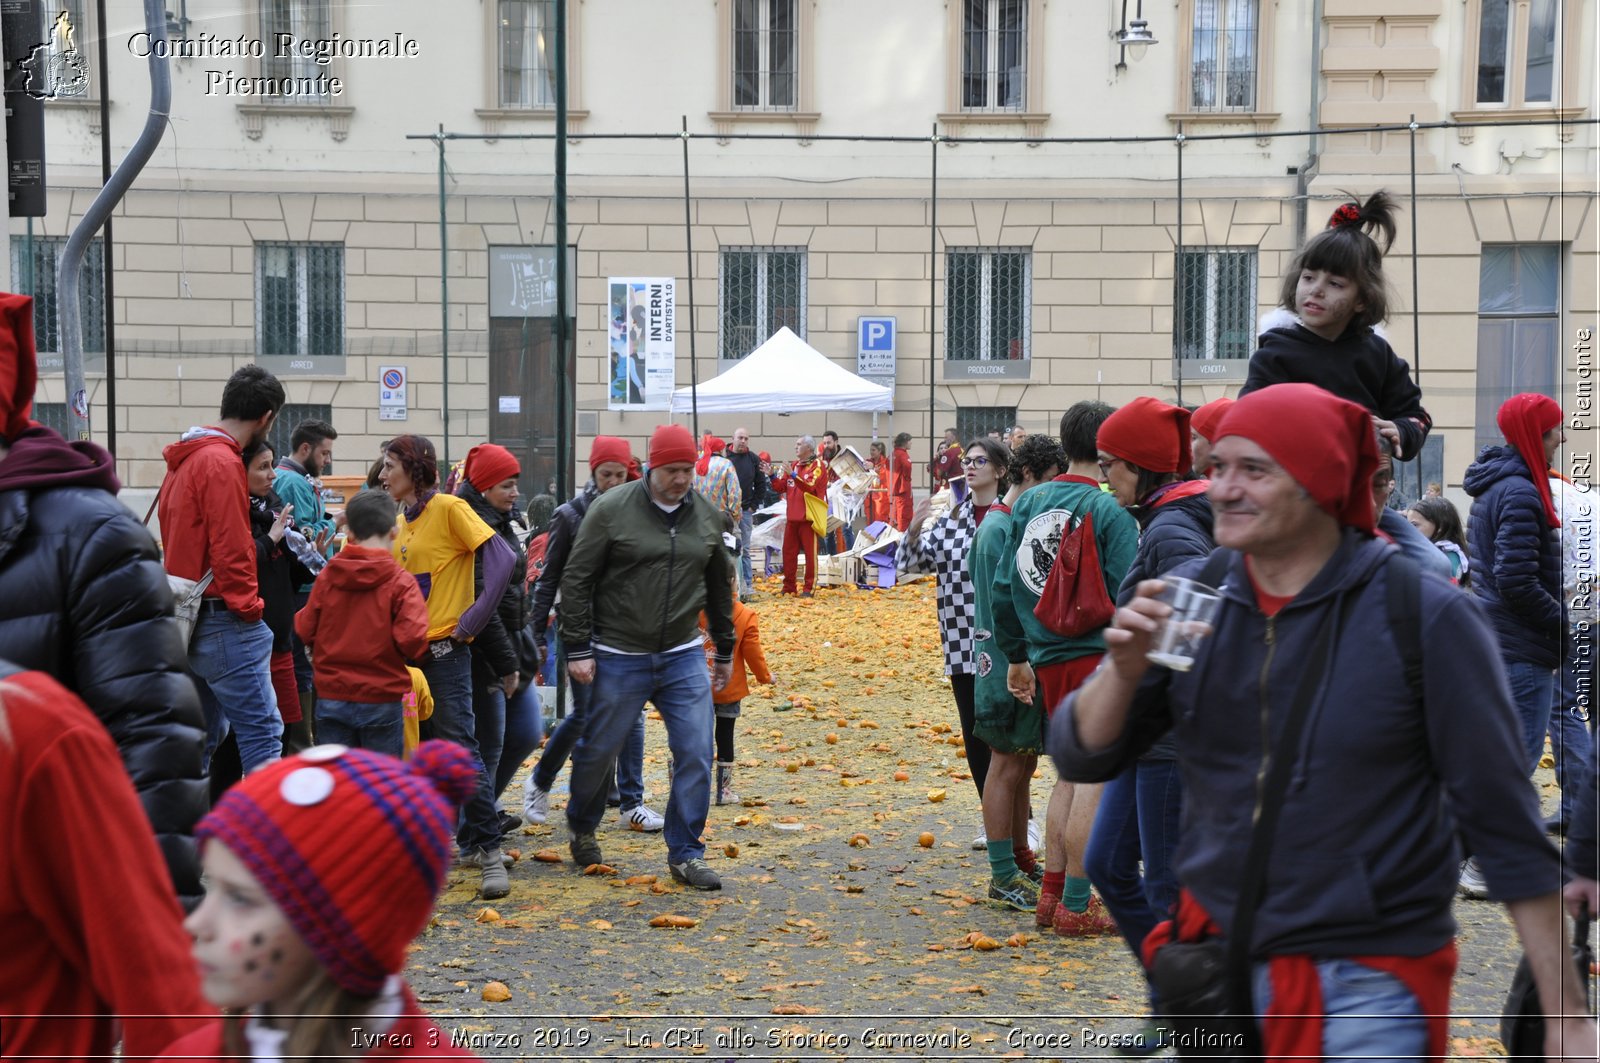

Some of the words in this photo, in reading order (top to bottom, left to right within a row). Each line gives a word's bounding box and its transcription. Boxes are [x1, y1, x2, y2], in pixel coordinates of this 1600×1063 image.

[650, 284, 662, 342] INTERNI
[665, 297, 673, 342] D'ARTISTA
[868, 322, 886, 348] P
[289, 360, 314, 370] ARREDI
[967, 365, 1007, 374] PRODUZIONE
[1199, 364, 1227, 374] VENDITA
